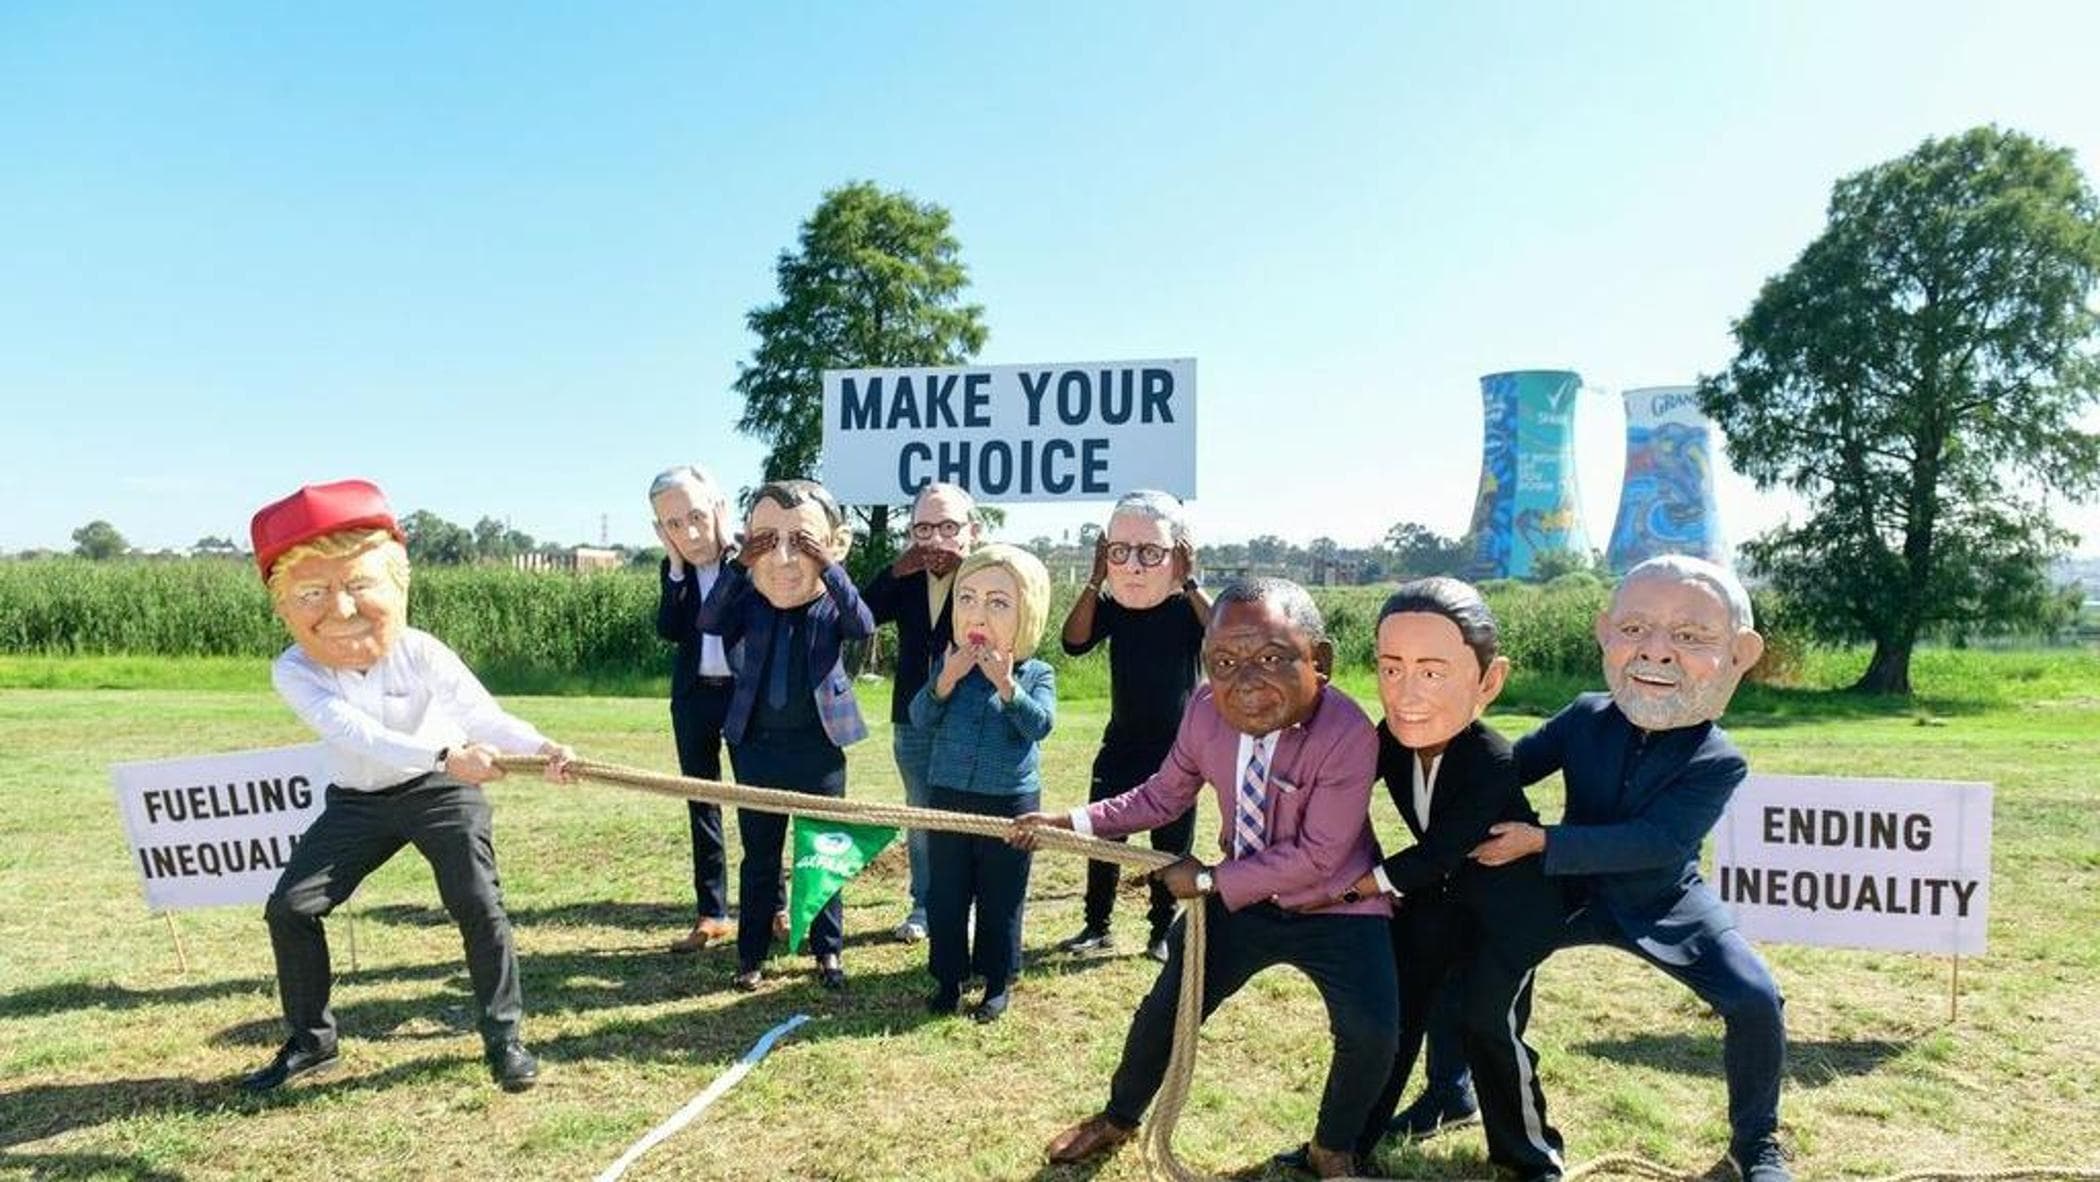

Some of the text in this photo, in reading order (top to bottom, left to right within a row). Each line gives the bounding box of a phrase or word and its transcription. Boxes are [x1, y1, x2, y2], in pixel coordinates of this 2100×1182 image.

[840, 368, 1174, 429] MAKE YOUR
[899, 438, 1110, 496] CHOICE
[143, 775, 312, 823] FUELLING
[1763, 806, 1932, 851] ENDING
[1720, 866, 1979, 917] INEQUALITY
